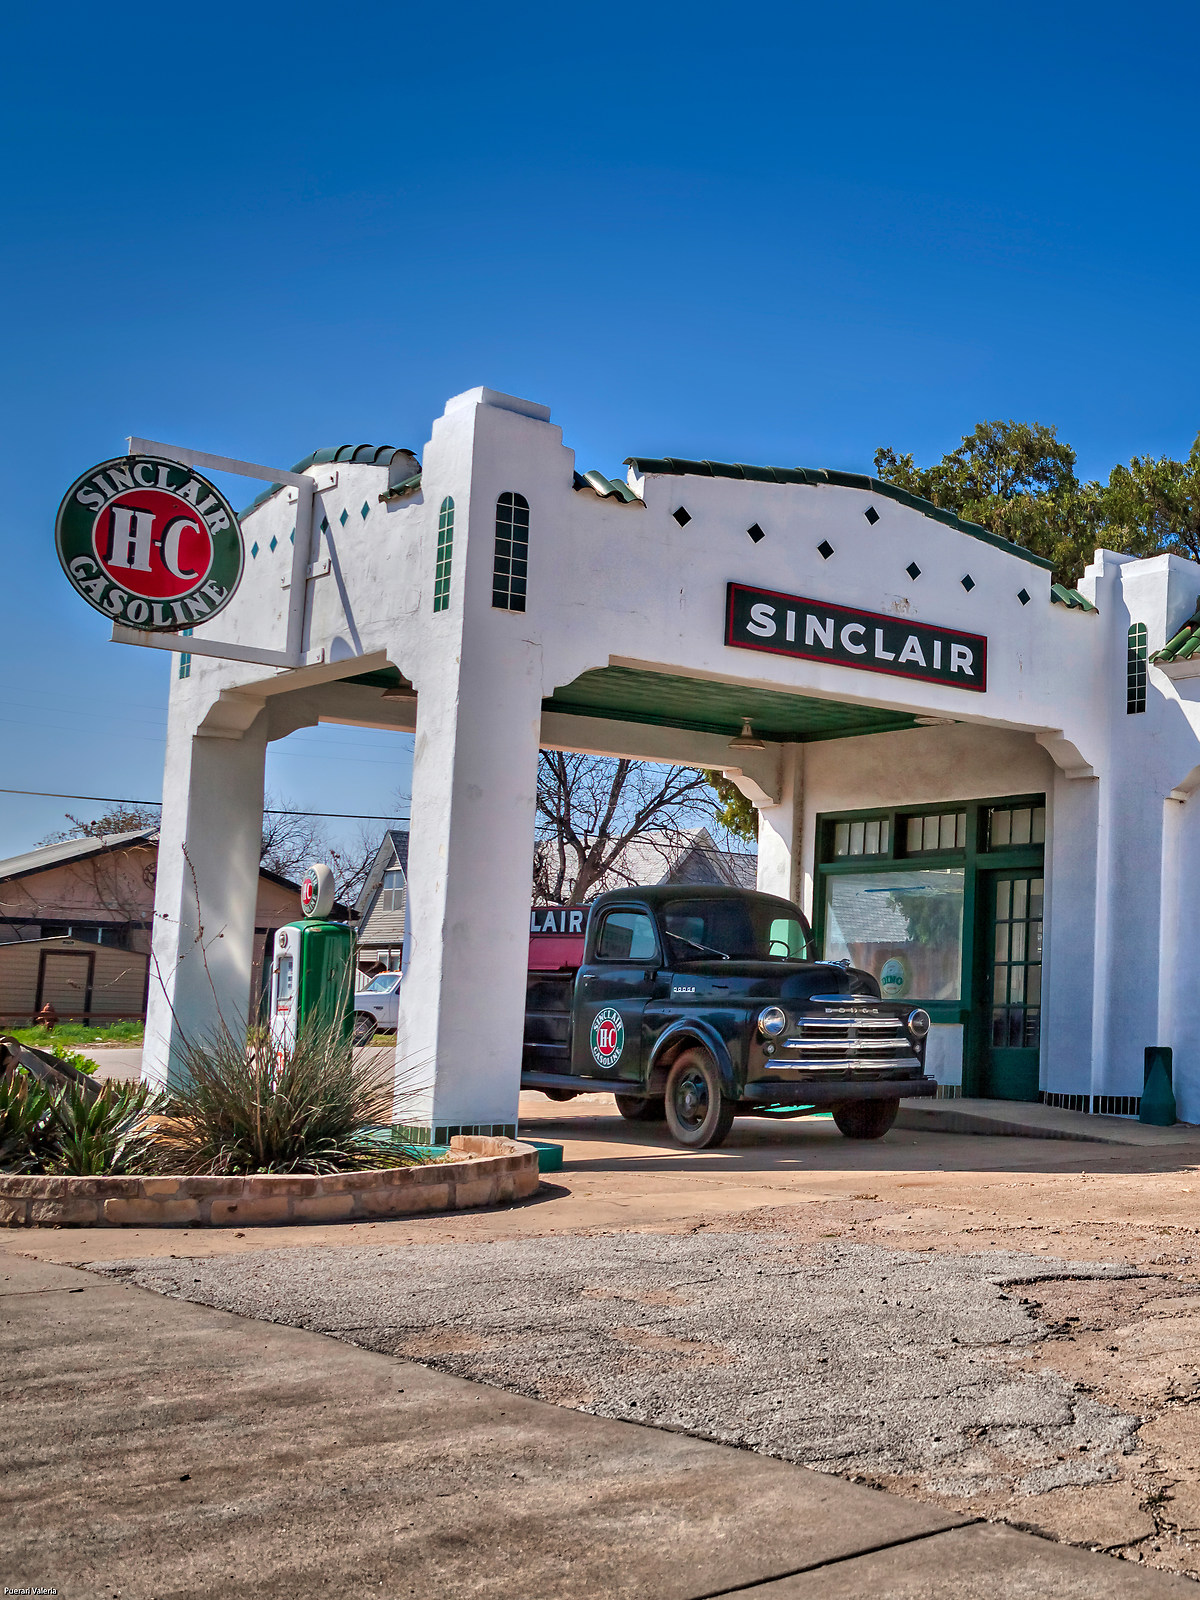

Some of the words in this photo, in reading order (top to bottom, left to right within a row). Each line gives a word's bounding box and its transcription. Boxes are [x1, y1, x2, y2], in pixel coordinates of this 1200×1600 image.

[76, 463, 231, 536] SINCLAIR
[69, 556, 228, 626] GASOLINE
[746, 603, 975, 676] SINCLAIR
[881, 975, 904, 985] DINO
[593, 1010, 622, 1032] SINCLAIR
[593, 1046, 622, 1066] GASOLINE
